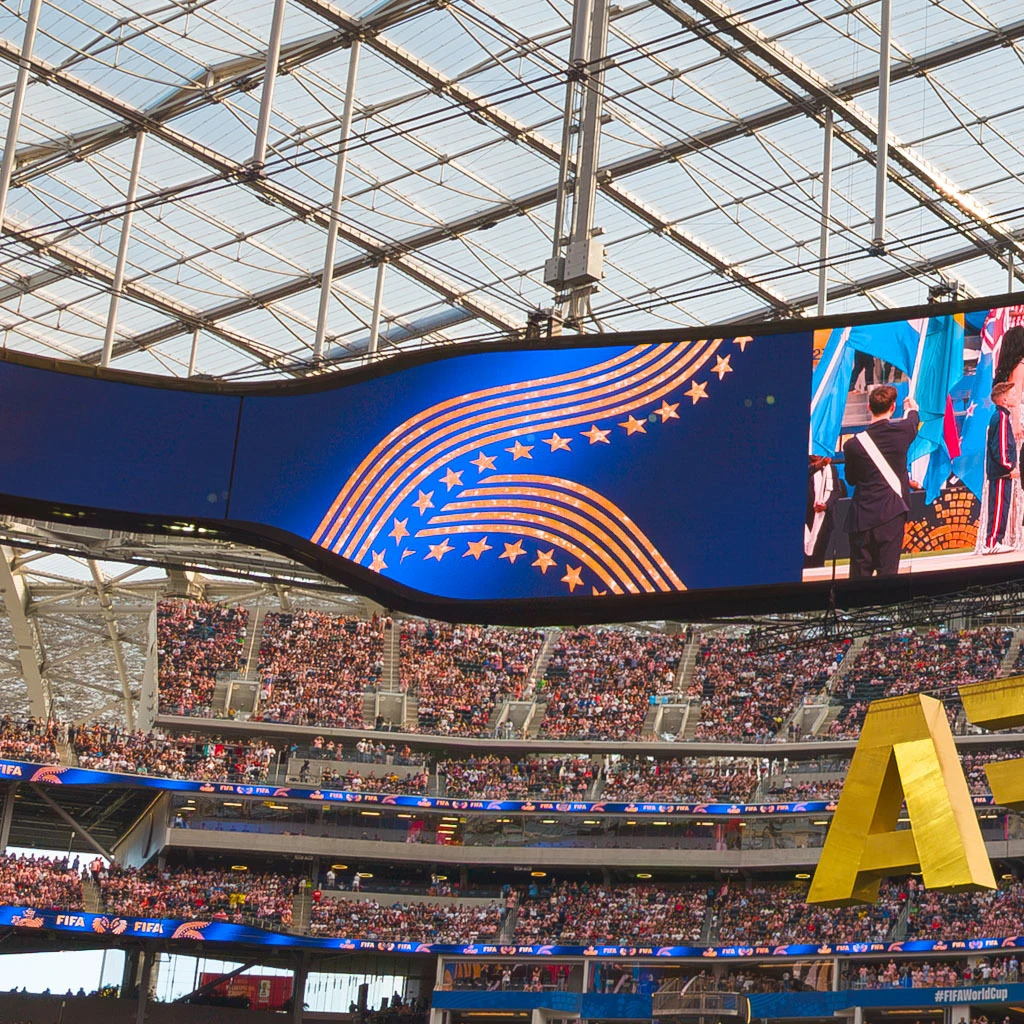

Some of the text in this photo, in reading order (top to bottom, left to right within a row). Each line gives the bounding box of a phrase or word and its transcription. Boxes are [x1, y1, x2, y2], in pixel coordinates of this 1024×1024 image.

[813, 348, 825, 360] 2
[0, 764, 22, 776] IFA
[220, 784, 234, 792] FIFA
[256, 787, 270, 795] FIFA
[329, 792, 343, 800] FIFA
[364, 794, 378, 802] FIFA
[974, 796, 986, 804] FIFA
[436, 799, 449, 807] FIFA
[470, 801, 483, 809] FIFA
[540, 802, 553, 810] FIFA
[574, 803, 587, 811] FIFA
[676, 804, 689, 812] FIFA
[745, 805, 757, 813] FIFA
[776, 804, 789, 812] FIFA
[56, 915, 85, 927] FIFA
[134, 921, 163, 934] FIFA
[360, 941, 375, 949] FIFA
[397, 943, 411, 951] FIFA
[870, 943, 884, 951] FIFA
[952, 940, 966, 949] FIFA
[985, 939, 998, 947] FIFA
[483, 945, 497, 953] FIFA
[519, 946, 533, 954] FIFA
[603, 947, 617, 955] FIFA
[638, 947, 653, 955] FIFA
[722, 947, 735, 955] FIFA
[756, 946, 769, 955] FIFA
[836, 944, 850, 952] FIFA
[934, 987, 1008, 1002] #FIFAWorldCup
